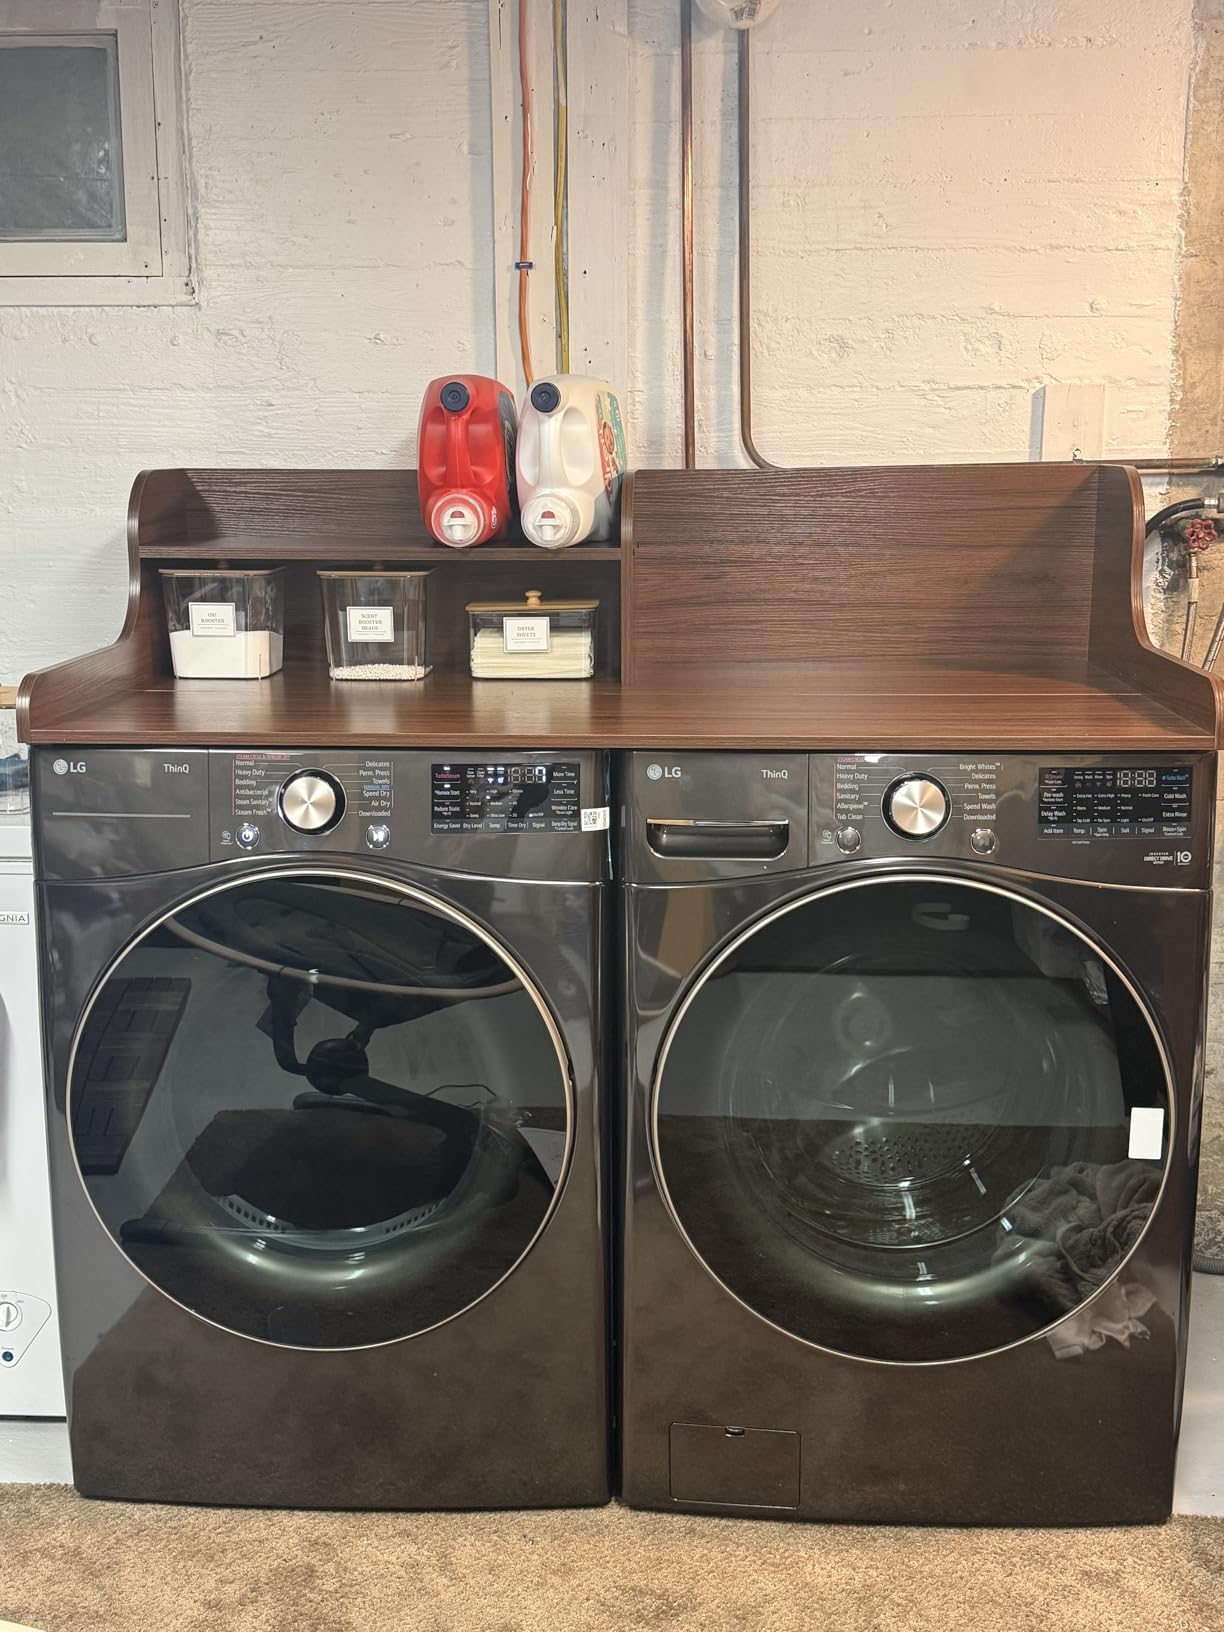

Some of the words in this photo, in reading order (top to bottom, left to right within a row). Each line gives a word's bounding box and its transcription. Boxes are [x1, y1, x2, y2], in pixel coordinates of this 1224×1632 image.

[70, 762, 86, 773] LG
[163, 764, 189, 774] ThinQ
[664, 766, 681, 778] LG
[959, 763, 976, 771] Bright
[761, 769, 788, 780] ThinQ
